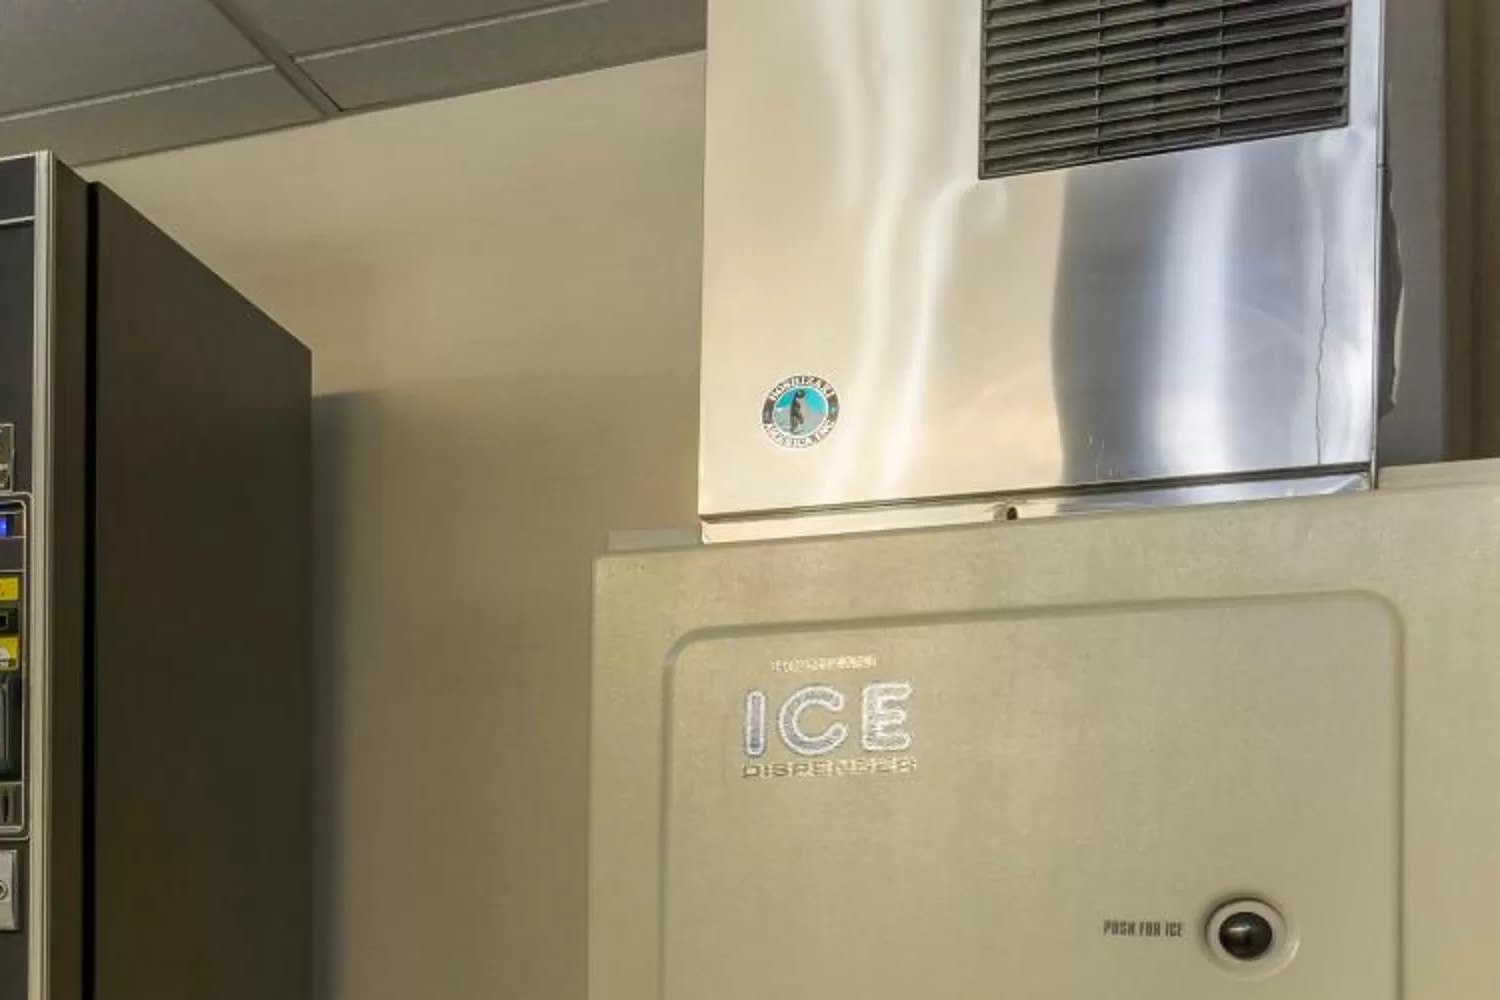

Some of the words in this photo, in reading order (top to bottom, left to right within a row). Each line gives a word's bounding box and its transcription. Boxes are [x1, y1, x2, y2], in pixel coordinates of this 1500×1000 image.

[746, 682, 914, 756] ICE
[1104, 920, 1136, 937] PUSH
[1139, 921, 1161, 937] FOR
[1165, 922, 1182, 938] ICE
